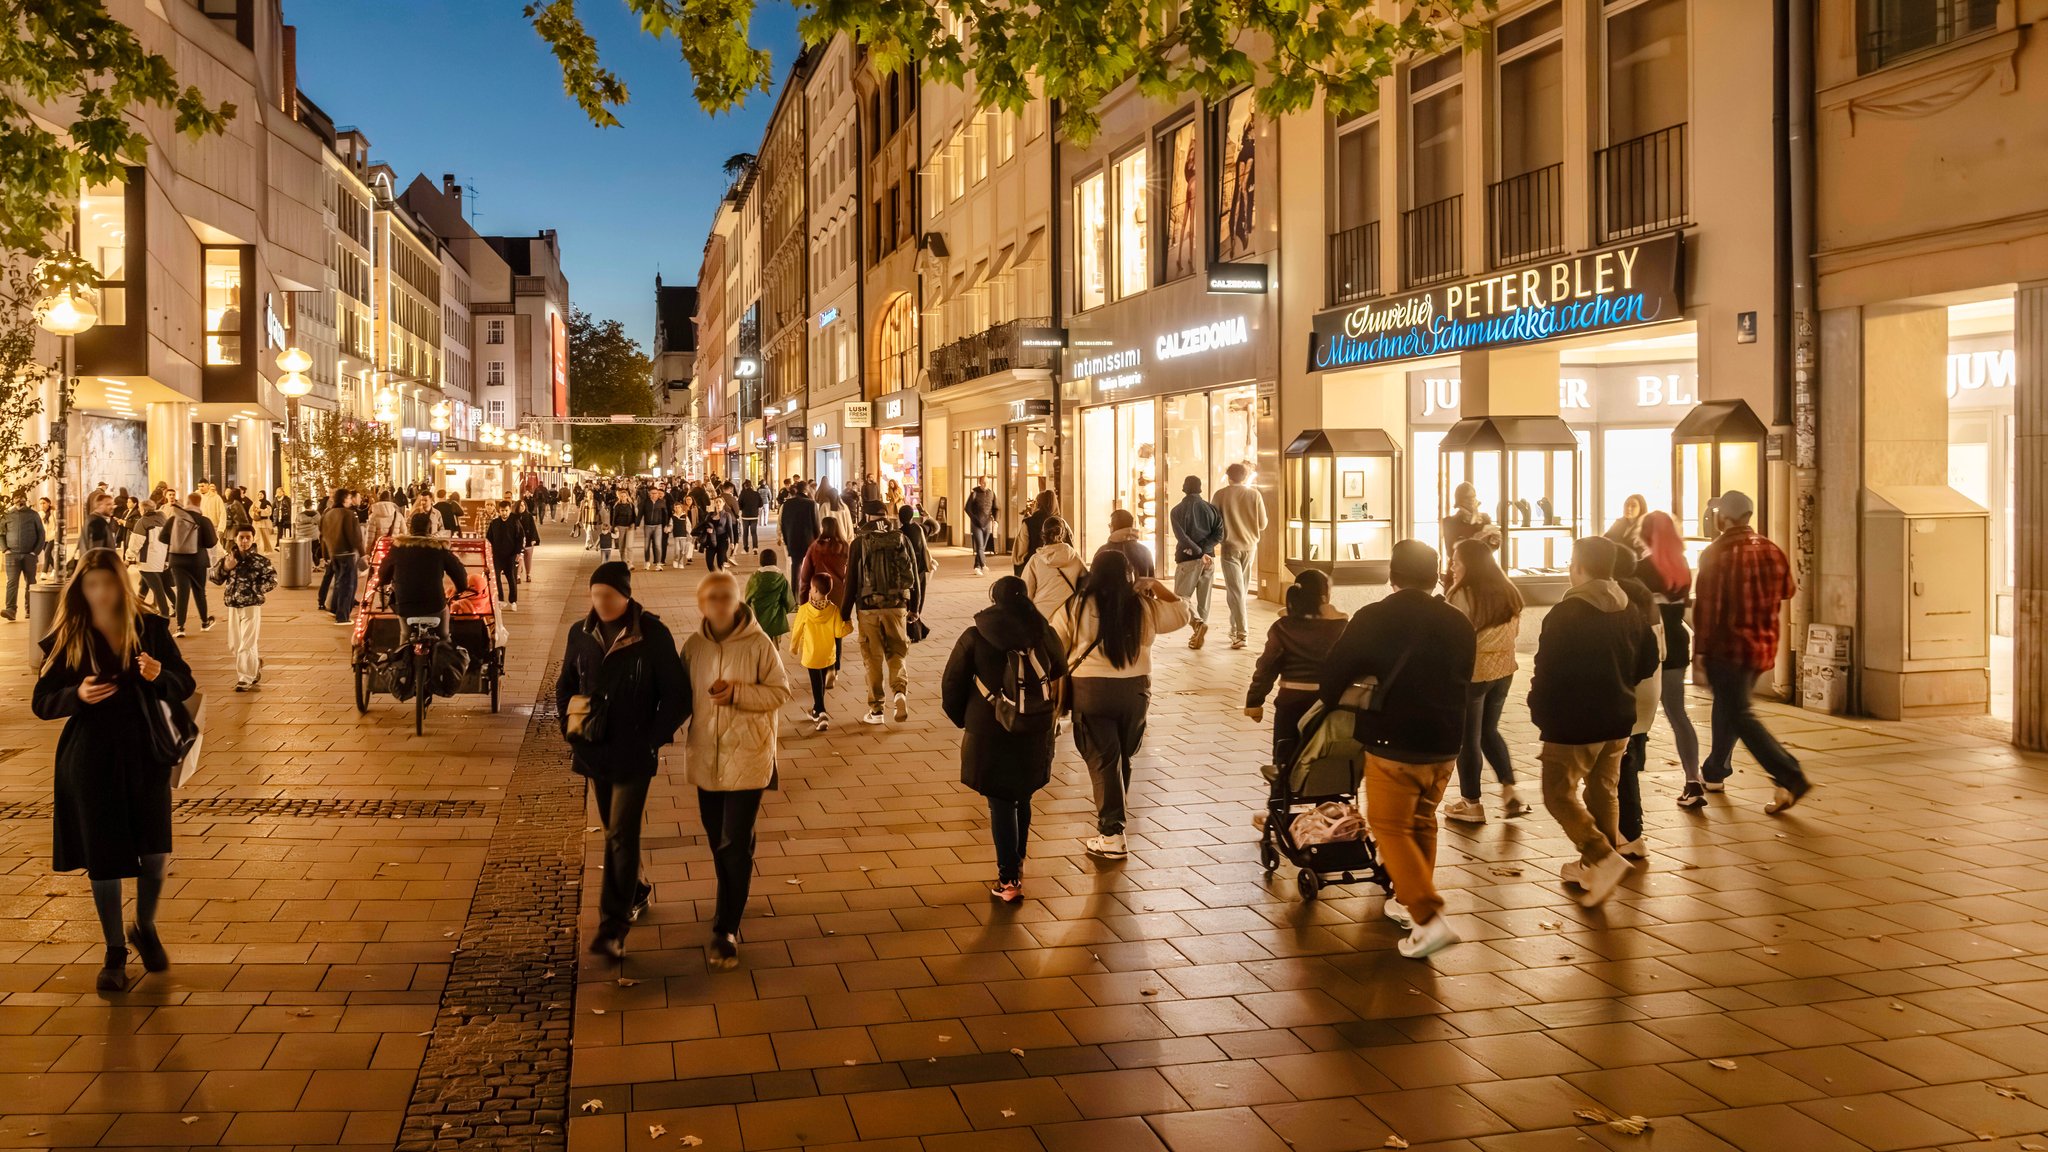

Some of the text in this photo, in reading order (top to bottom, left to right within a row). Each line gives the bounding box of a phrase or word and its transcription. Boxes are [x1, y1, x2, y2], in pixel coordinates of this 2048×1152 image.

[1344, 246, 1640, 339] Juwelier PETER BLEY
[1155, 316, 1248, 361] CALZEDONIA
[1316, 292, 1662, 367] Münchner Schmuckkästchen
[1742, 314, 1751, 330] 4
[1073, 348, 1141, 379] intimissimi
[1636, 374, 1702, 407] BL
